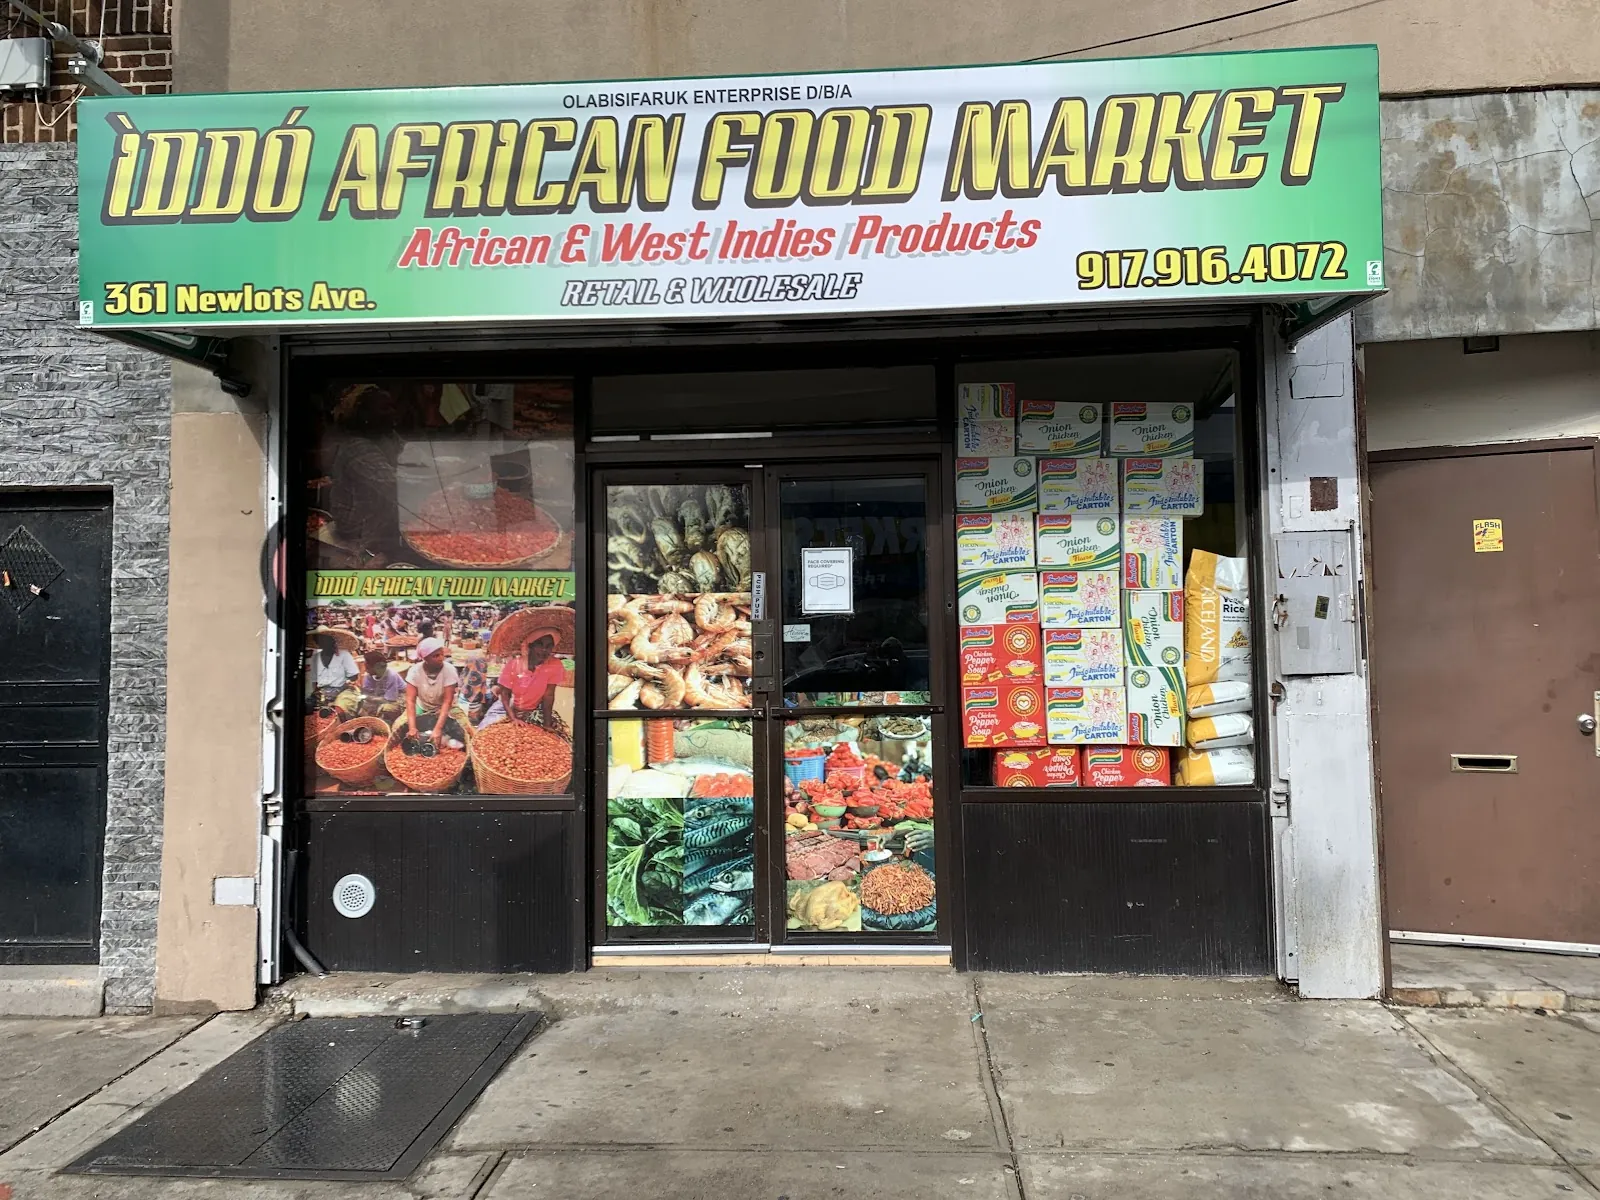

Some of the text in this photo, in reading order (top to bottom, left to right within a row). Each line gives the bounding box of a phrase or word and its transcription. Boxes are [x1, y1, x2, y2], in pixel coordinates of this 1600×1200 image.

[562, 84, 852, 109] OLABISIFARUK ENTERPRISE D/B/A
[318, 112, 685, 220] AFRICAN
[694, 104, 933, 210] FOOD
[941, 83, 1346, 201] MARKET
[397, 210, 1042, 268] African & West Indies Products
[1076, 241, 1348, 289] 917.916.4072
[561, 272, 863, 307] RETAIL & WHOLESALE
[104, 281, 377, 315] 361 Newlots Ave.
[1039, 423, 1073, 433] Onion
[1132, 424, 1166, 435] Onion
[1048, 432, 1080, 440] Chicken
[1142, 432, 1173, 442] Chicken
[975, 478, 1008, 490] Onion
[984, 485, 1016, 497] Chicken
[1076, 502, 1110, 510] CARTON
[1161, 502, 1195, 510] CARTON
[1475, 522, 1500, 530] FLASH
[1057, 536, 1091, 548] Onion
[1170, 522, 1178, 554] CARTON
[1067, 544, 1101, 555] Chicken
[993, 556, 1026, 564] CARTON
[360, 574, 437, 596] AFRICAN
[438, 574, 491, 597] FOOD
[490, 575, 570, 597] MARKET
[976, 584, 1009, 596] Chicken
[986, 591, 1019, 604] Onion
[1223, 603, 1245, 613] Rice
[1078, 615, 1111, 623] CARTON
[1149, 607, 1161, 640] Onion
[1200, 586, 1217, 663] RICELAND
[1141, 616, 1152, 650] Chicken
[964, 654, 996, 666] Pepper
[967, 664, 989, 675] Soup
[1082, 673, 1116, 681] CARTON
[1159, 685, 1170, 719] Chicken
[1150, 694, 1163, 728] Onion
[969, 715, 1000, 728] Pepper
[972, 725, 992, 737] Soup
[1085, 731, 1118, 740] CARTON
[1049, 754, 1071, 765] Soup
[1043, 764, 1075, 775] Pepper
[1092, 770, 1125, 784] Pepper
